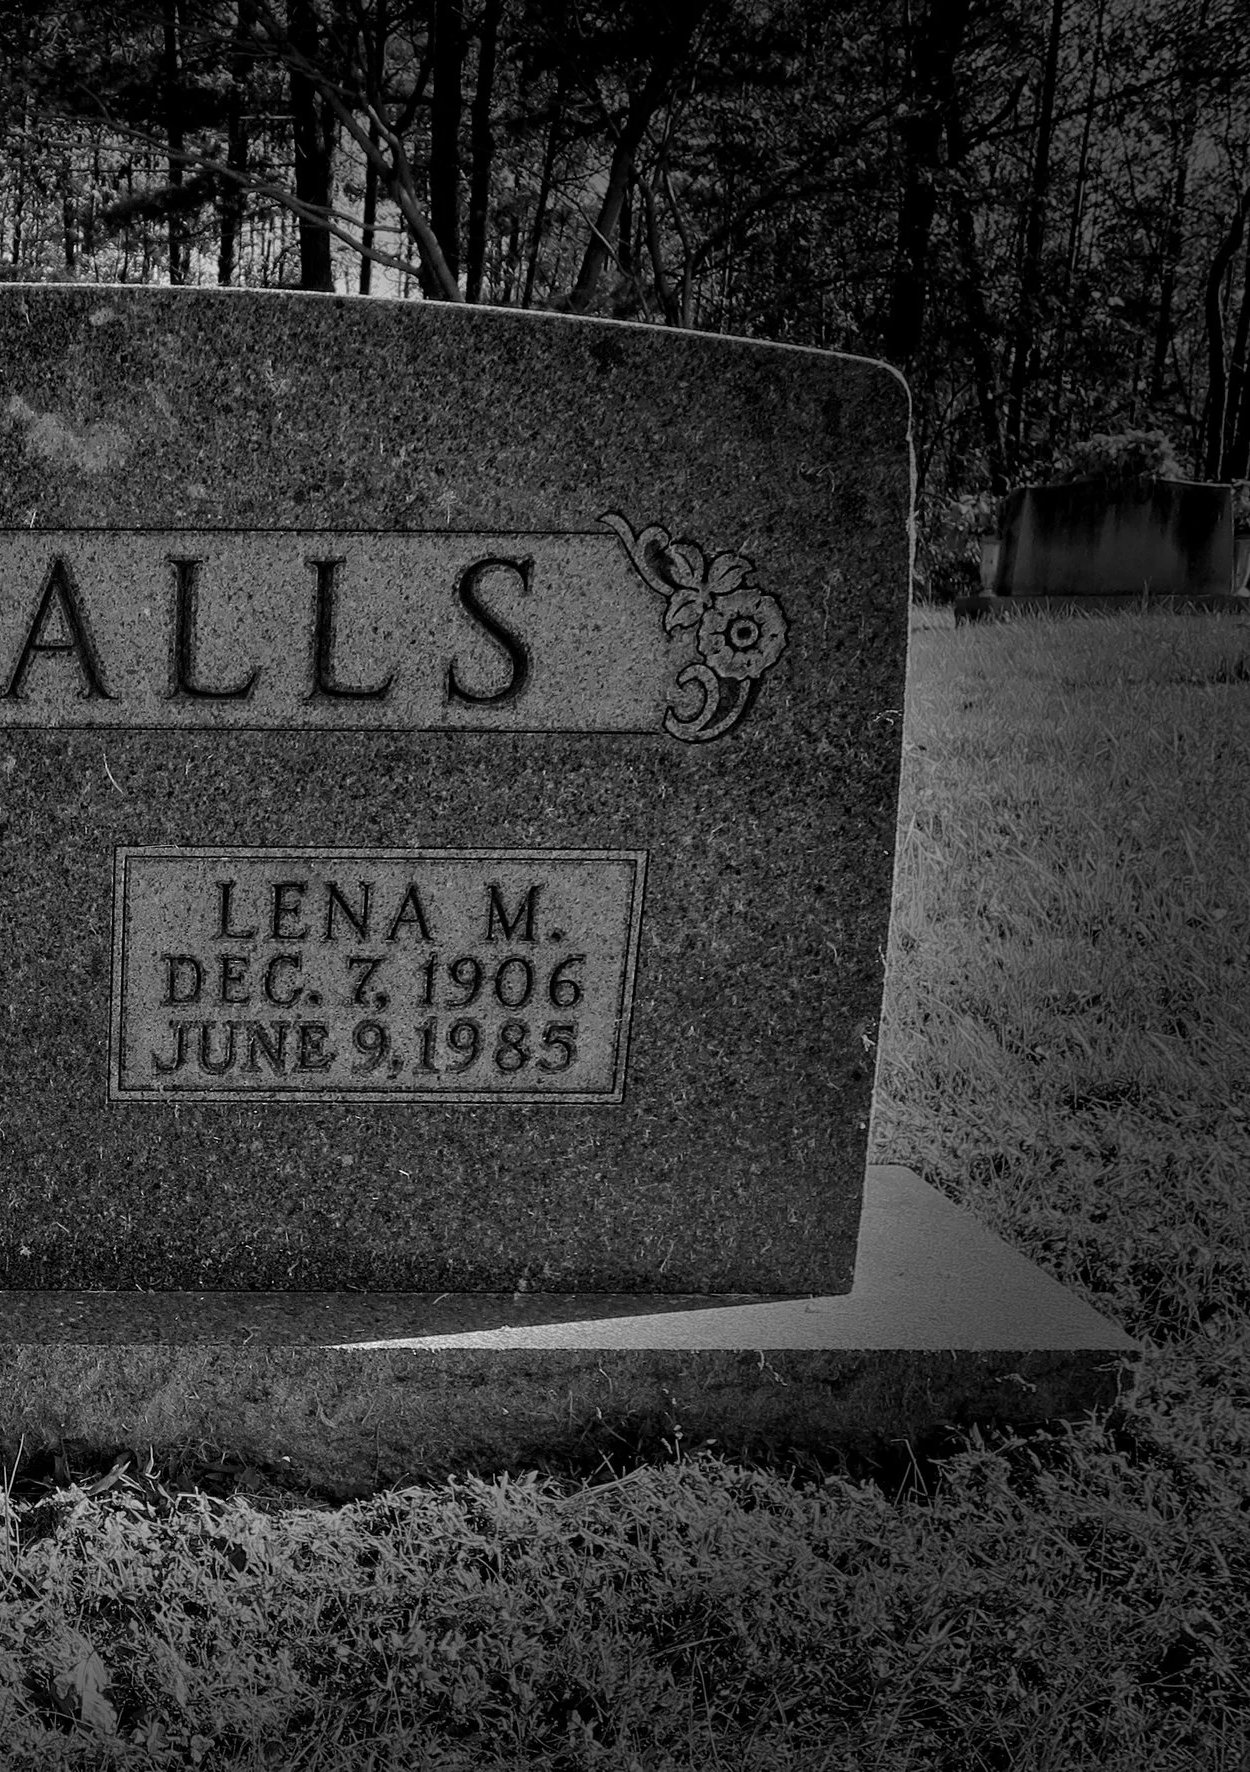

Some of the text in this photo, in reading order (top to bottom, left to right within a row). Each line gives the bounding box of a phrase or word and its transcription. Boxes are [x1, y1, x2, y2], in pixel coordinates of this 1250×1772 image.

[214, 879, 566, 943] LENA M.
[157, 952, 324, 1008] DEC.
[152, 1017, 337, 1077] JUNE
